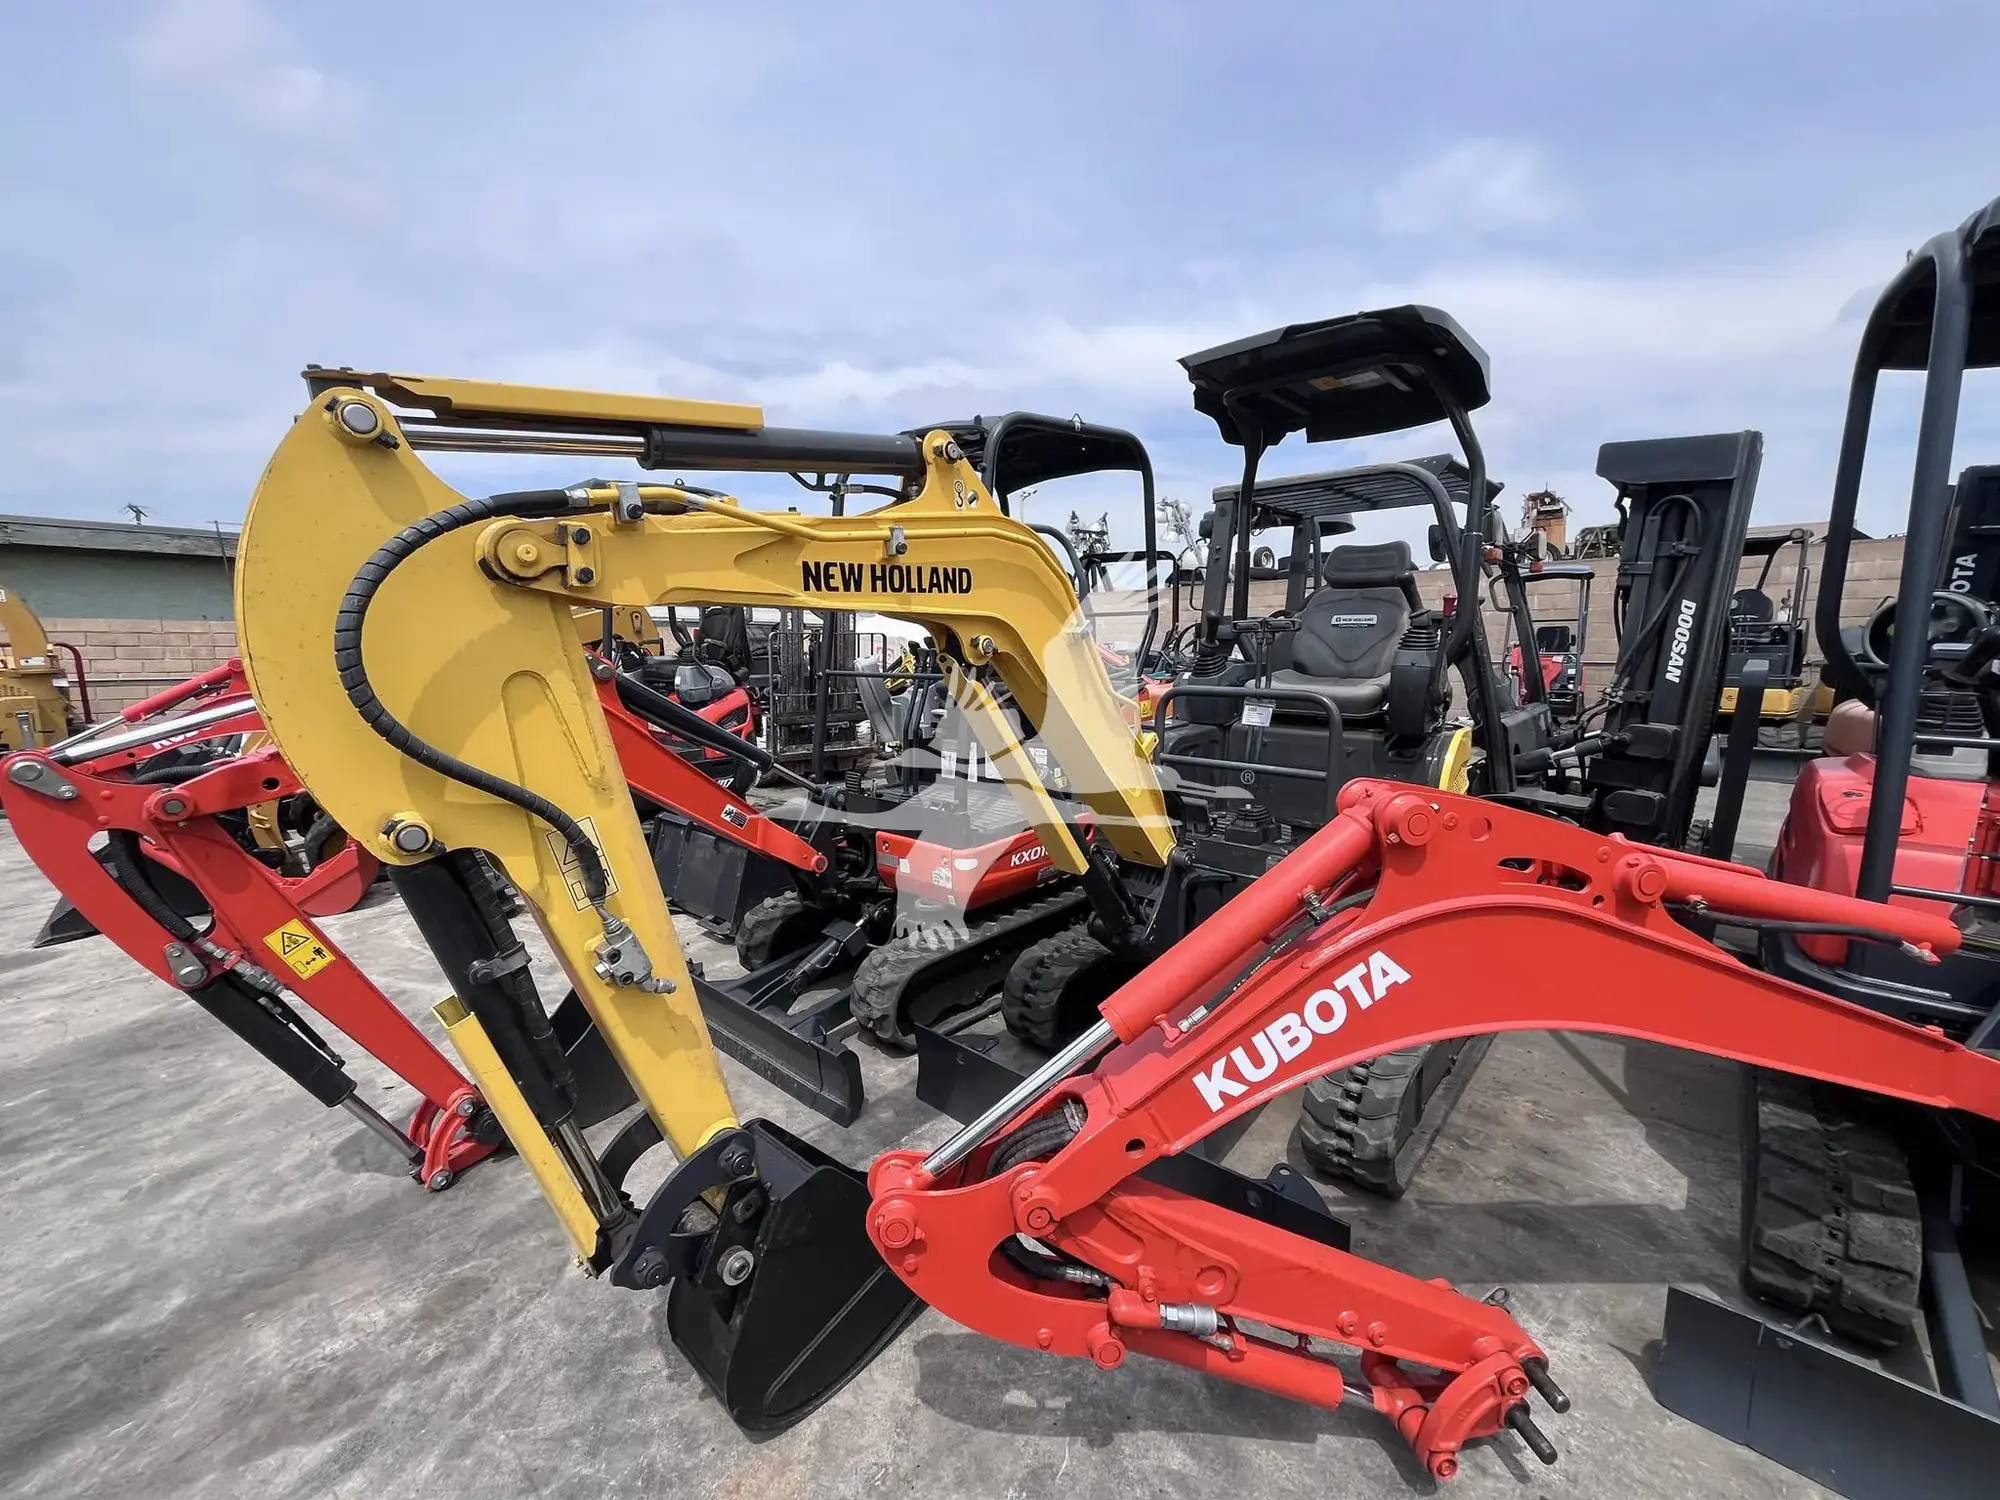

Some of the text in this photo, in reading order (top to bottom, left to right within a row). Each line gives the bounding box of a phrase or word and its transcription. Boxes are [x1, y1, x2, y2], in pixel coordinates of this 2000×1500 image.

[801, 560, 973, 594] NEW HOLLAND
[1949, 553, 1978, 593] OTA
[1665, 599, 1697, 684] DOOSAN
[1010, 845, 1049, 867] KX01
[1192, 950, 1412, 1113] KUBOTA
